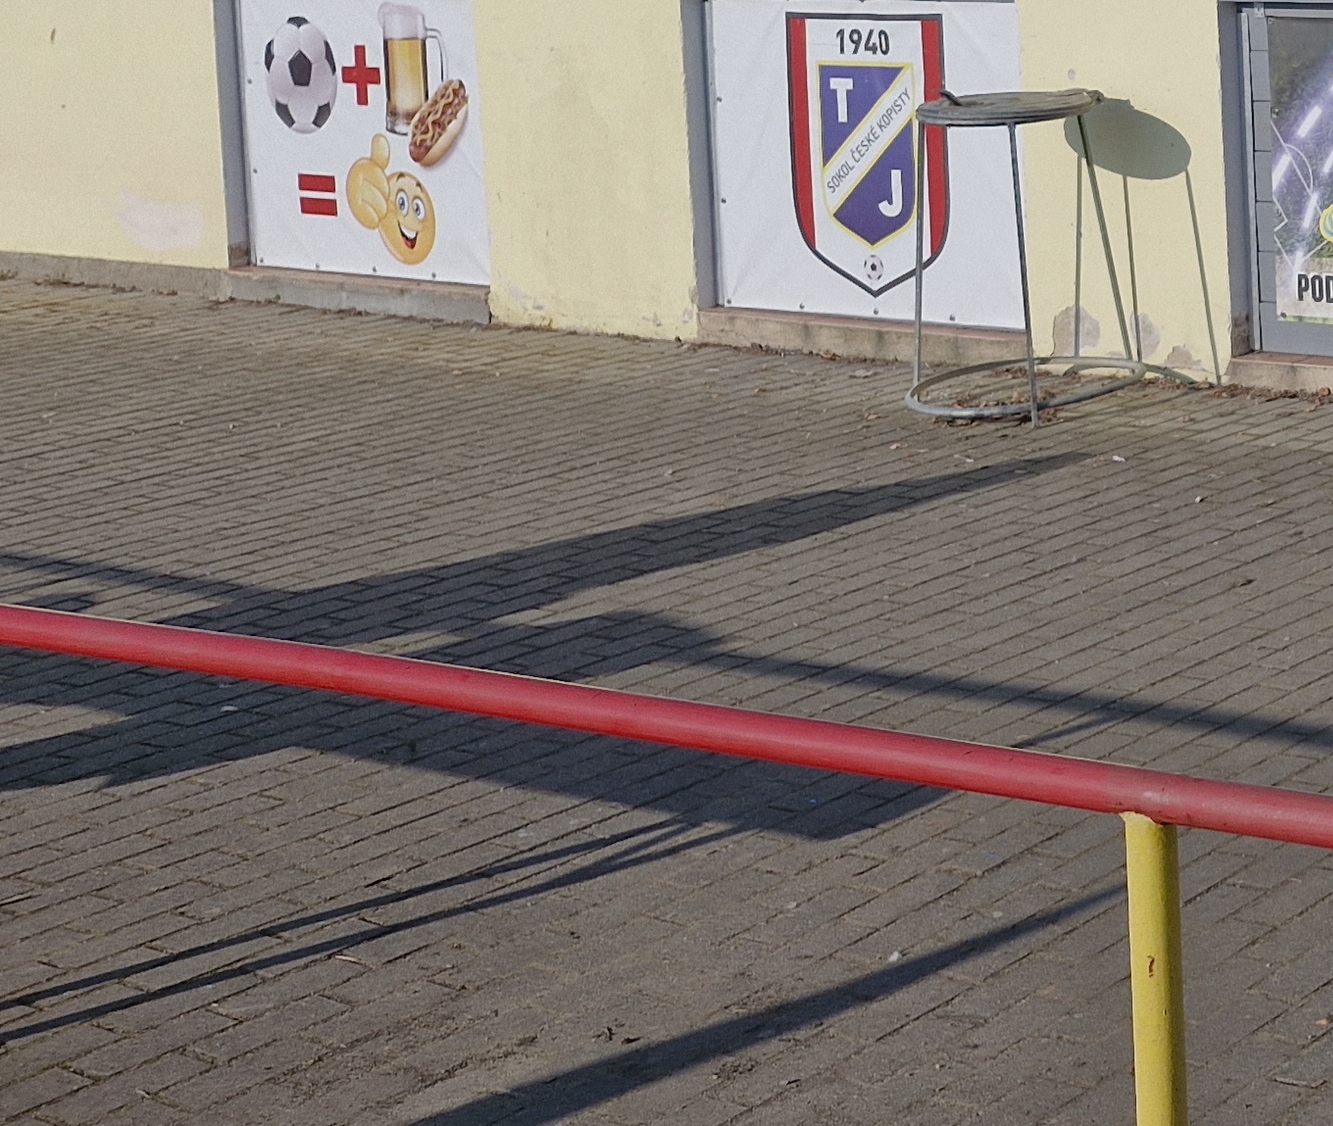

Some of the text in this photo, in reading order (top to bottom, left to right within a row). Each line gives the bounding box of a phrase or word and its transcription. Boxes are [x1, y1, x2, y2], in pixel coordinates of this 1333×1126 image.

[835, 28, 891, 56] 1940
[829, 77, 854, 123] T
[826, 87, 911, 194] SOKOL ČESKÉ KOPISTY
[877, 169, 904, 218] J
